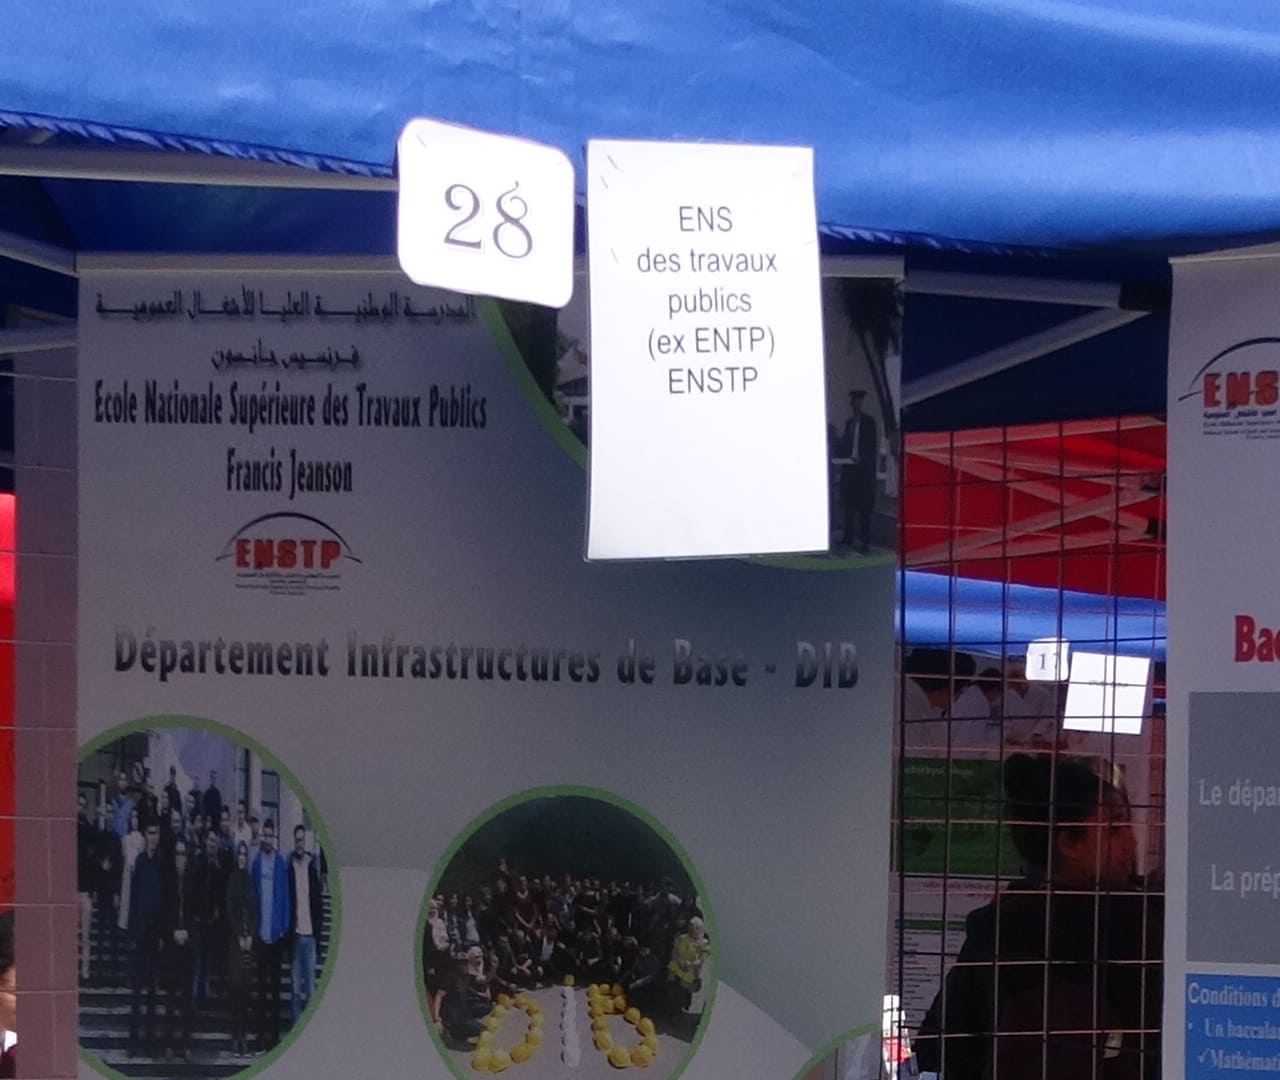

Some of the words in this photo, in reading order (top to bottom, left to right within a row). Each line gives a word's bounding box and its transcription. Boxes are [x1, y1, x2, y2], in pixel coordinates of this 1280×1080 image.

[444, 182, 534, 260] 28
[679, 206, 733, 232] ENS
[637, 248, 681, 273] des
[690, 249, 777, 273] travaux
[668, 288, 752, 318] publics
[648, 328, 688, 358] (ex
[696, 327, 775, 357] ENTP)
[668, 367, 759, 394] ENSTP
[95, 381, 139, 425] Ecole
[145, 381, 223, 426] Nationale
[229, 382, 317, 434] Supérieure
[323, 384, 350, 429] des
[356, 386, 422, 429] Travaux
[429, 387, 487, 429] Publics
[227, 449, 282, 493] Francis
[290, 449, 352, 497] Jeanson
[235, 538, 341, 570] ENSTP
[115, 628, 330, 682] Département
[348, 632, 600, 685] Infrastructures
[616, 639, 655, 683] de
[673, 640, 748, 687] Base
[797, 642, 860, 690] DIB
[1188, 982, 1267, 1007] Conditions
